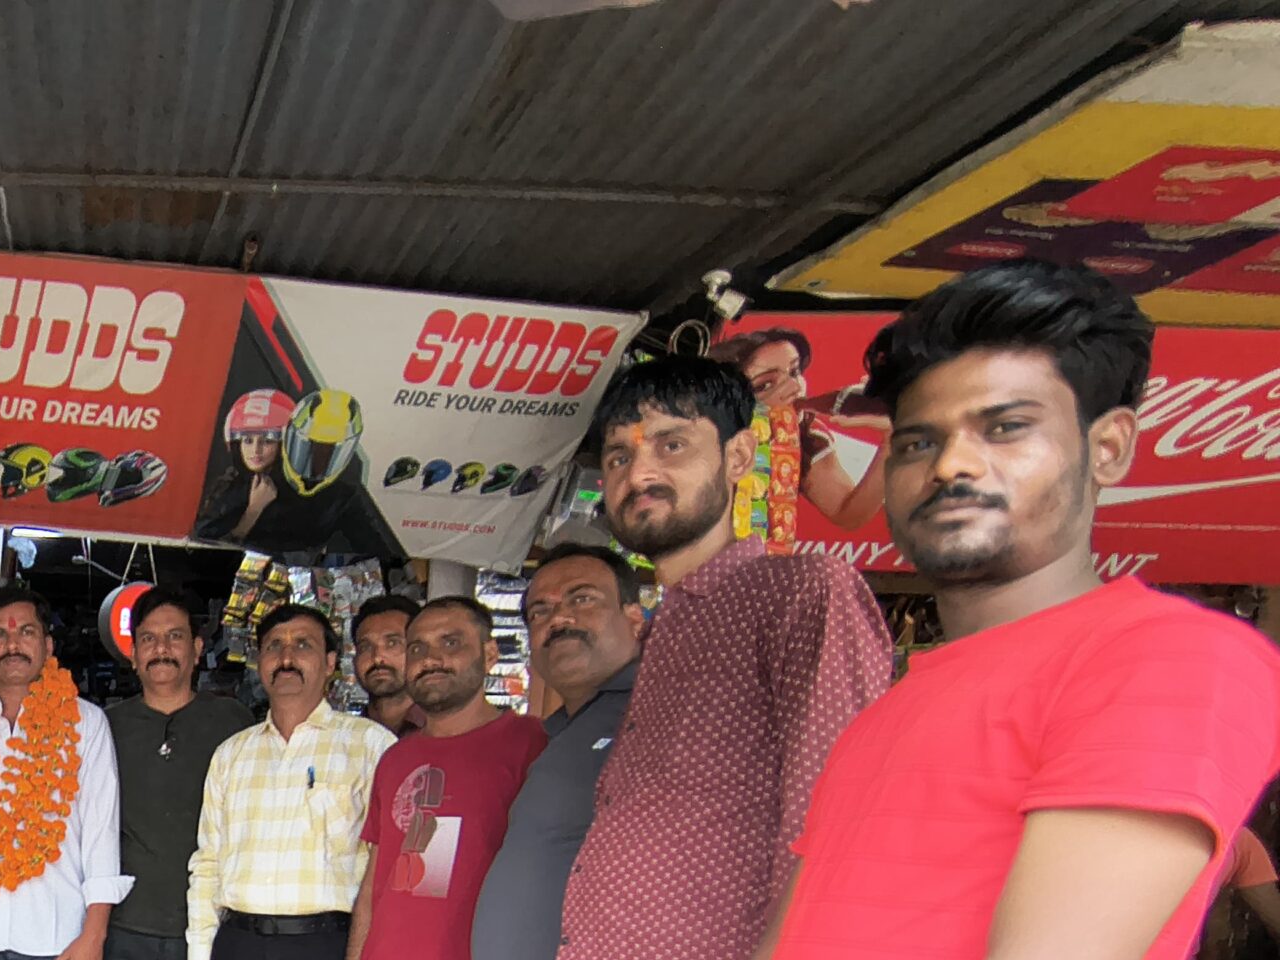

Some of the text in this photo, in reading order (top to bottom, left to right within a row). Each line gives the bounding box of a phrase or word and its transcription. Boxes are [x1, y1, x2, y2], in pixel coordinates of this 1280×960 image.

[403, 308, 619, 397] STUDDS
[42, 400, 161, 430] DREAMS
[394, 388, 580, 417] RIDE YOUR DREAMS
